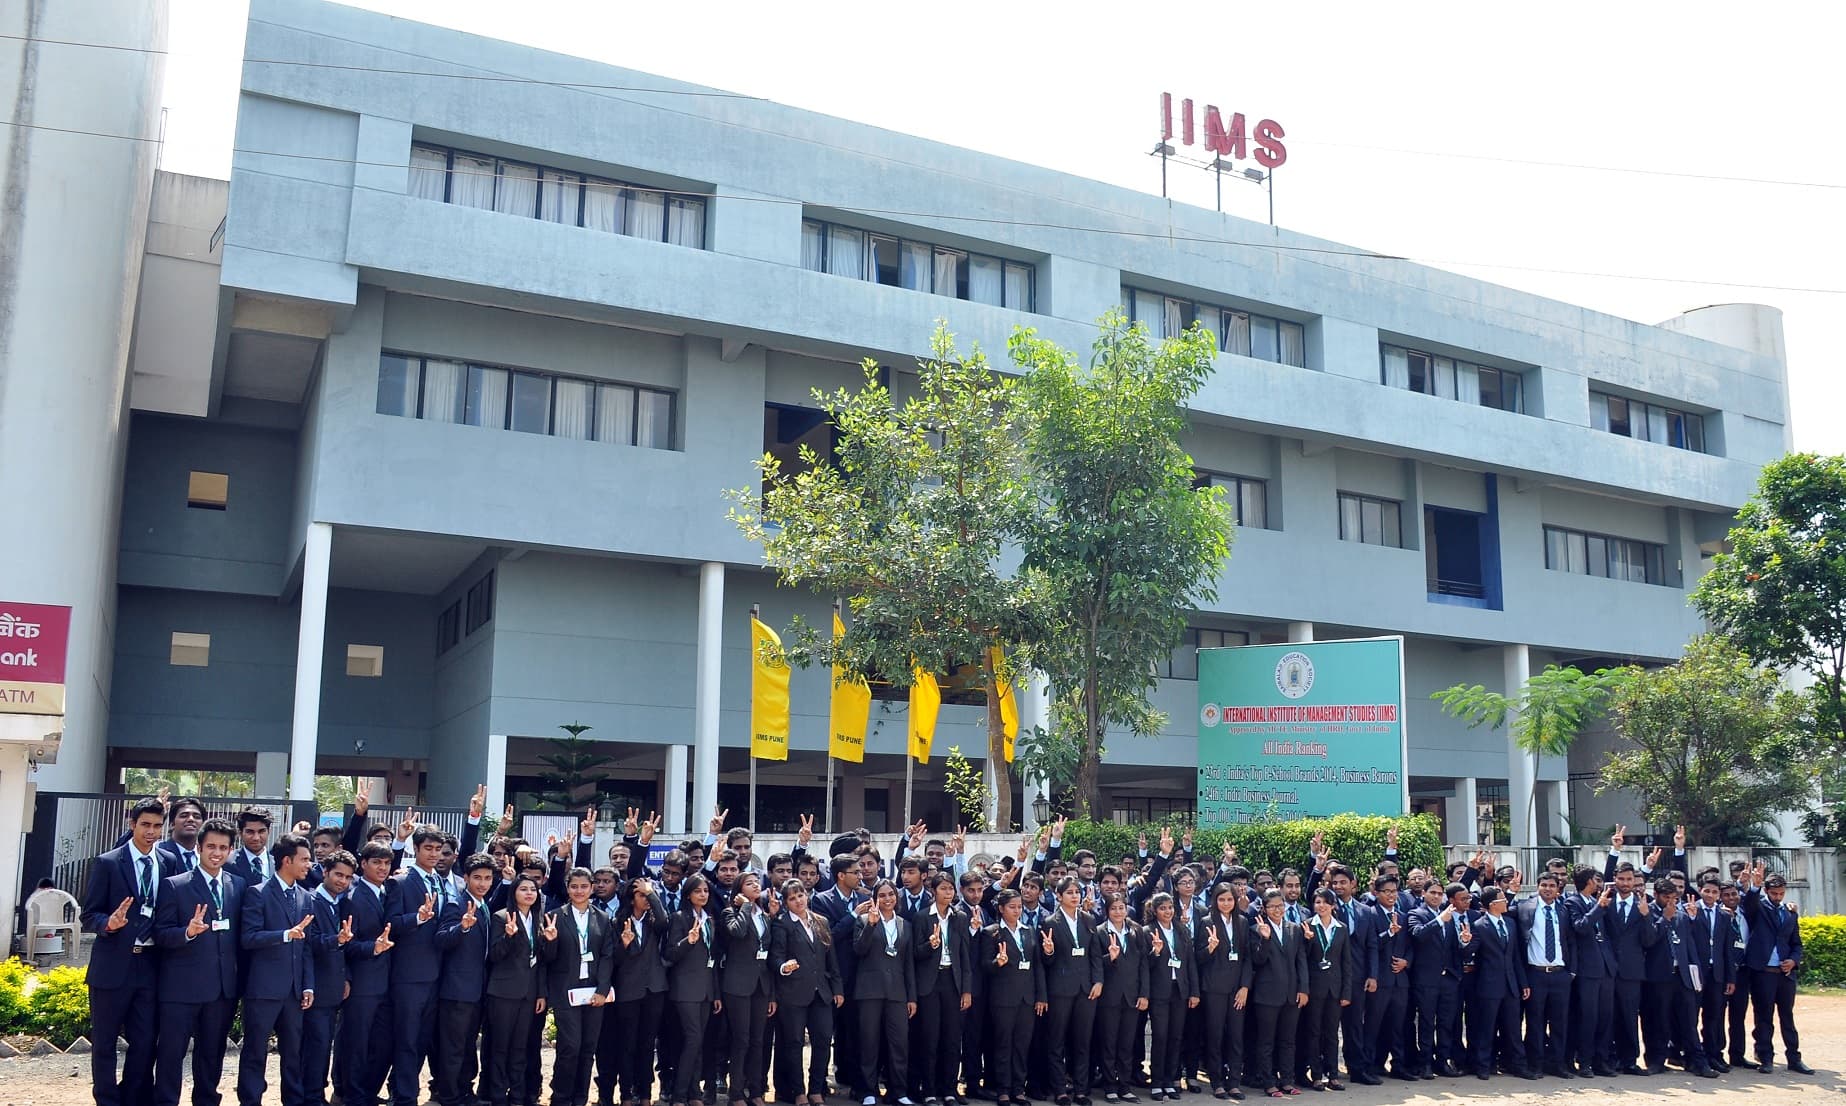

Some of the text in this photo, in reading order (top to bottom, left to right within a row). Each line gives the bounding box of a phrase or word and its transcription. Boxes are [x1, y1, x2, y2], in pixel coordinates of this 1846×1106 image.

[1160, 92, 1287, 168] IIMS
[0, 648, 38, 667] ank
[0, 688, 35, 703] ATM
[1223, 707, 1266, 722] INTERNATIONAL
[1268, 706, 1297, 722] INSTITUTE
[1298, 706, 1306, 721] OF
[1307, 706, 1348, 721] MANAGEMENT
[1349, 705, 1376, 721] STUDIES
[1263, 740, 1327, 759] All India Ranking
[1250, 765, 1263, 785] Top
[1264, 766, 1293, 782] B-School
[1295, 766, 1319, 782] Brands
[1340, 767, 1370, 784] Business
[1371, 767, 1397, 784] Barons
[1224, 786, 1240, 802] India
[1243, 787, 1270, 803] Business
[1205, 807, 1217, 827] Top
